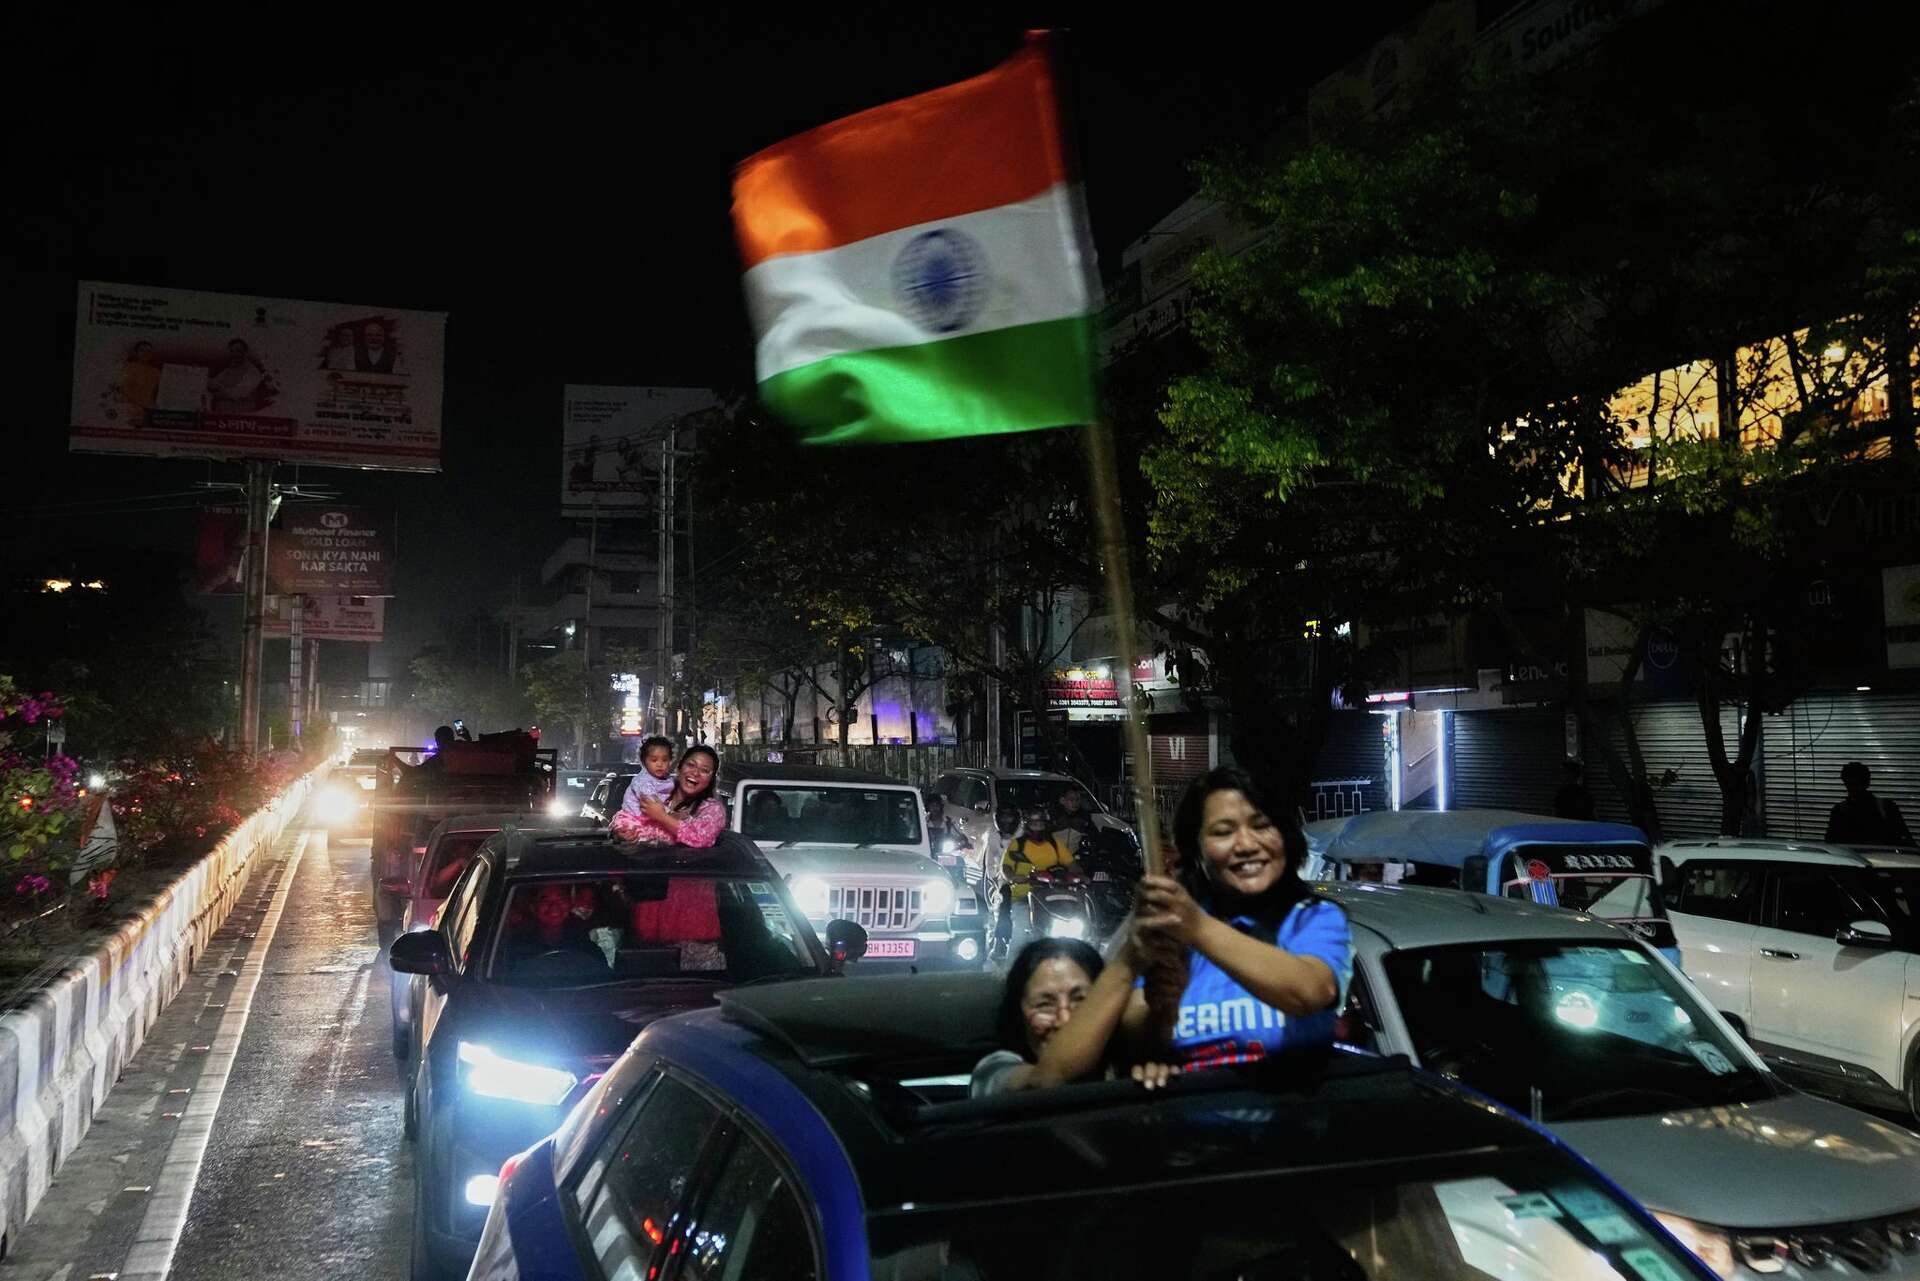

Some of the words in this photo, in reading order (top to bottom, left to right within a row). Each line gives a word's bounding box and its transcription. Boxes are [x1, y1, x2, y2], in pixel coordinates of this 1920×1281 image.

[337, 528, 376, 537] Finance
[303, 537, 332, 547] GOLD
[335, 537, 366, 548] LOAN
[286, 550, 320, 561] SONA
[322, 551, 348, 561] KYA
[350, 551, 381, 562] NAHI
[301, 561, 326, 572] KAR
[328, 562, 368, 573] SAKTA
